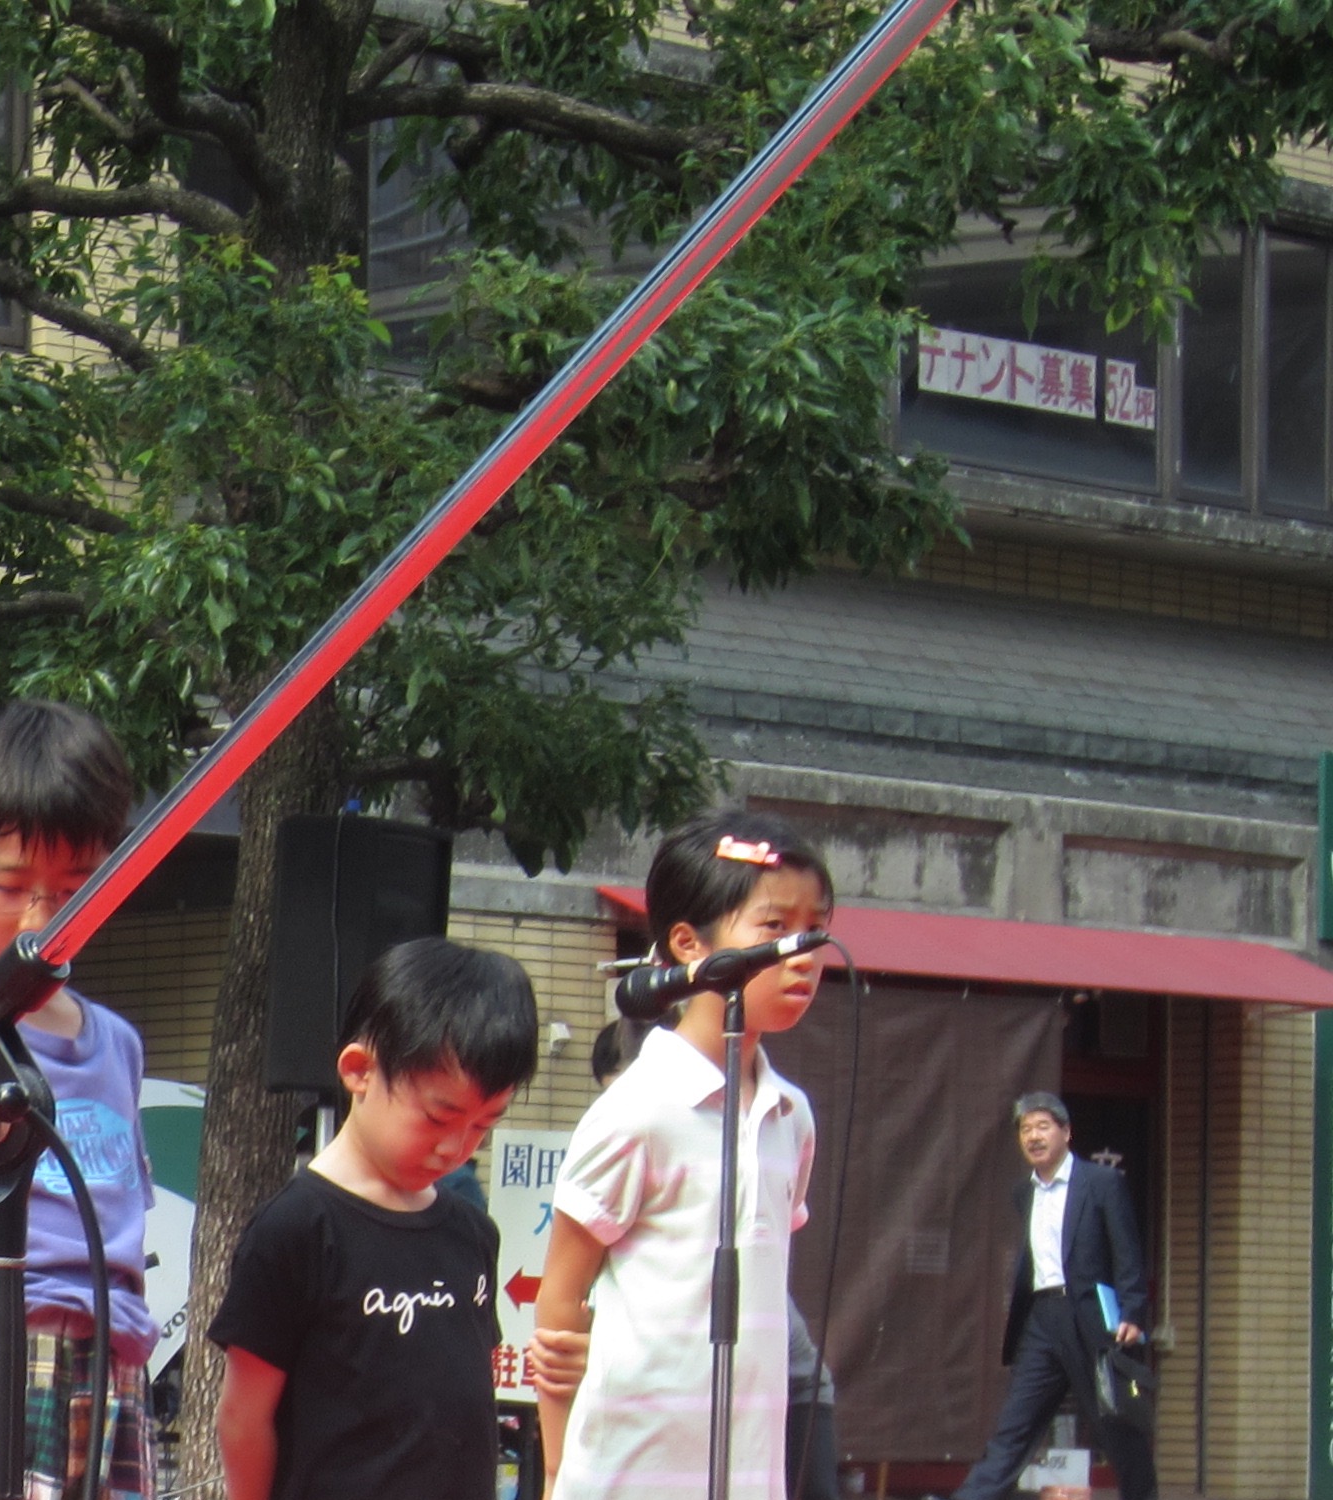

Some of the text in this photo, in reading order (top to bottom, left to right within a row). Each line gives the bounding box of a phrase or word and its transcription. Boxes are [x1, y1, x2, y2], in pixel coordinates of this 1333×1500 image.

[919, 331, 1154, 430] テナント募集 52坪
